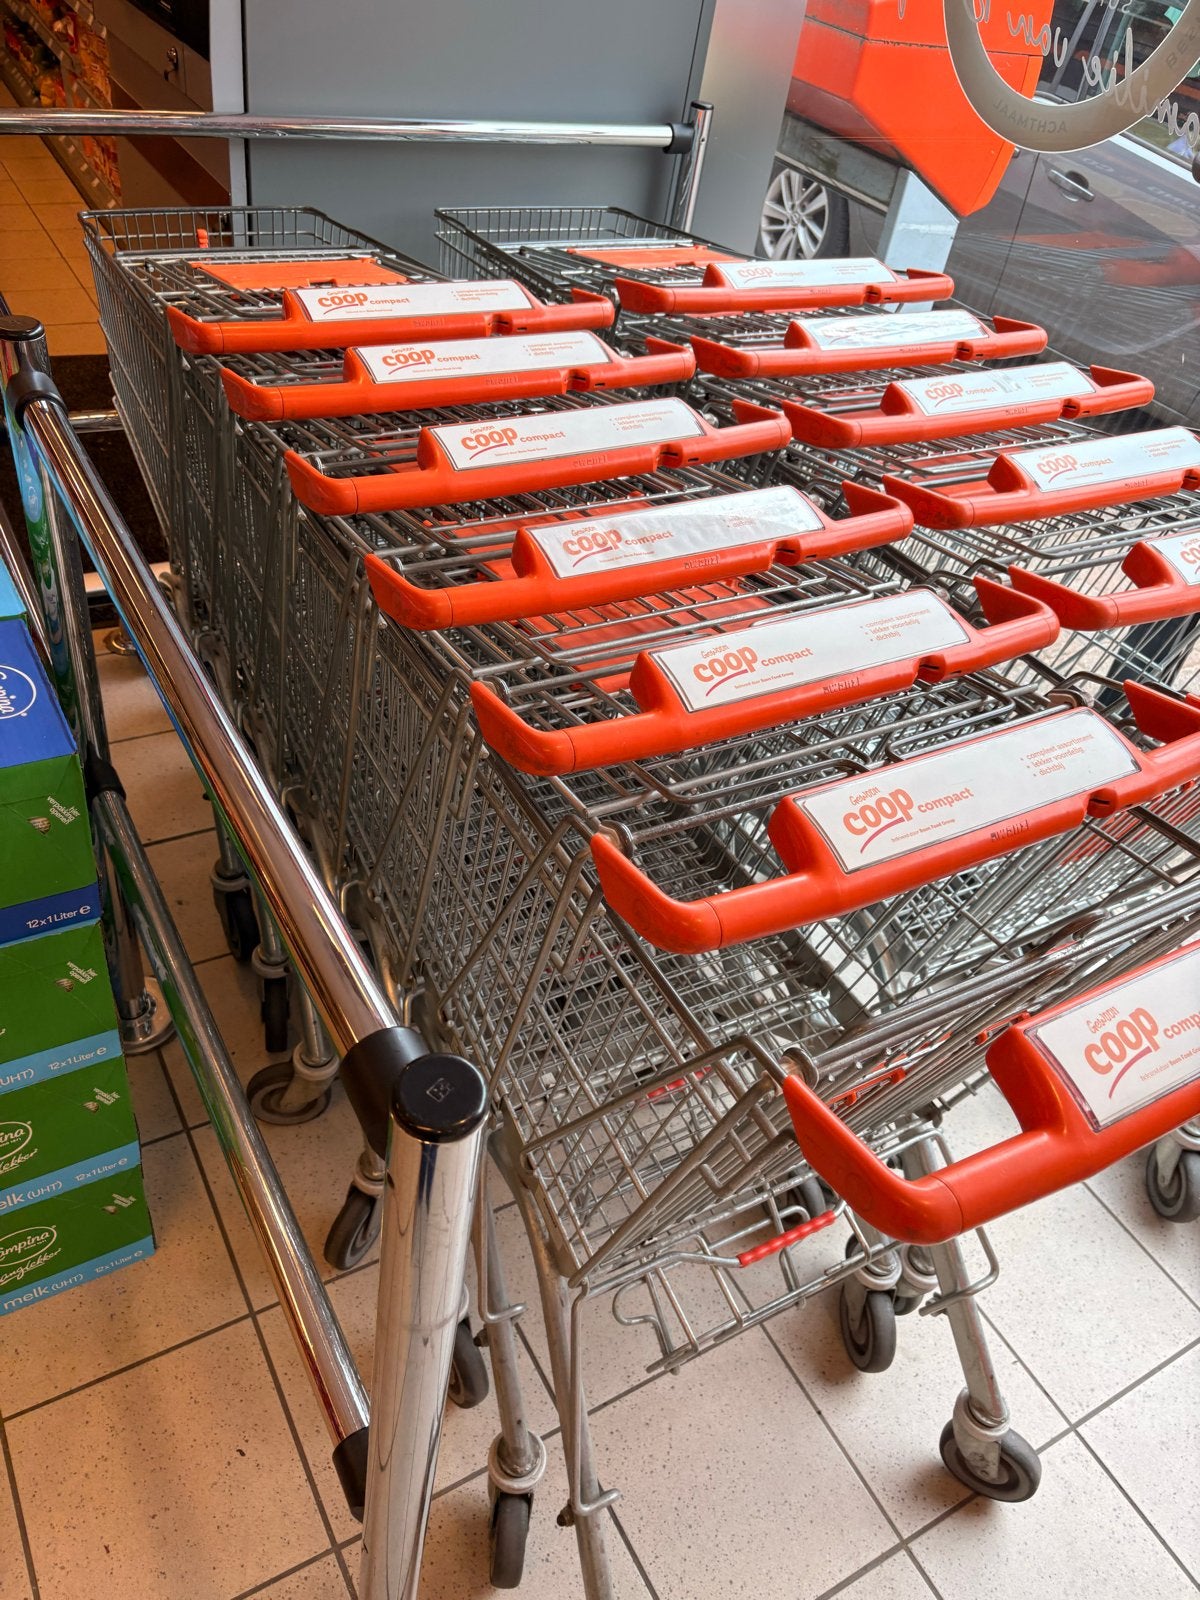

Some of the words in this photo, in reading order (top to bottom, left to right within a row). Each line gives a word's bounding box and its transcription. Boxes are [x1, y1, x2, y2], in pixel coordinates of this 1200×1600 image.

[738, 266, 773, 278] coop
[318, 292, 368, 307] coop
[382, 349, 436, 367] coop
[437, 354, 481, 363] compact
[925, 382, 964, 400] coop
[460, 427, 518, 450] coop
[520, 431, 566, 443] compact
[1036, 453, 1078, 475] coop
[562, 529, 623, 556] coop
[624, 530, 674, 546] compact
[692, 646, 758, 682] coop
[761, 647, 814, 667] compact
[849, 786, 881, 806] Gewoon
[842, 788, 914, 836] coop
[917, 787, 975, 813] compact
[54, 910, 78, 922] Liter
[1086, 1006, 1120, 1034] Gewoon
[1084, 1007, 1160, 1075] coop
[1163, 1010, 1200, 1039] comp
[73, 1051, 95, 1063] Liter
[0, 1192, 25, 1210] elk
[27, 1180, 63, 1200] (UHT)
[97, 1163, 117, 1174] Liter
[0, 1232, 50, 1258] ampina
[0, 1248, 61, 1282] anglekker
[3, 1286, 50, 1310] melk
[51, 1273, 84, 1291] (UHT)
